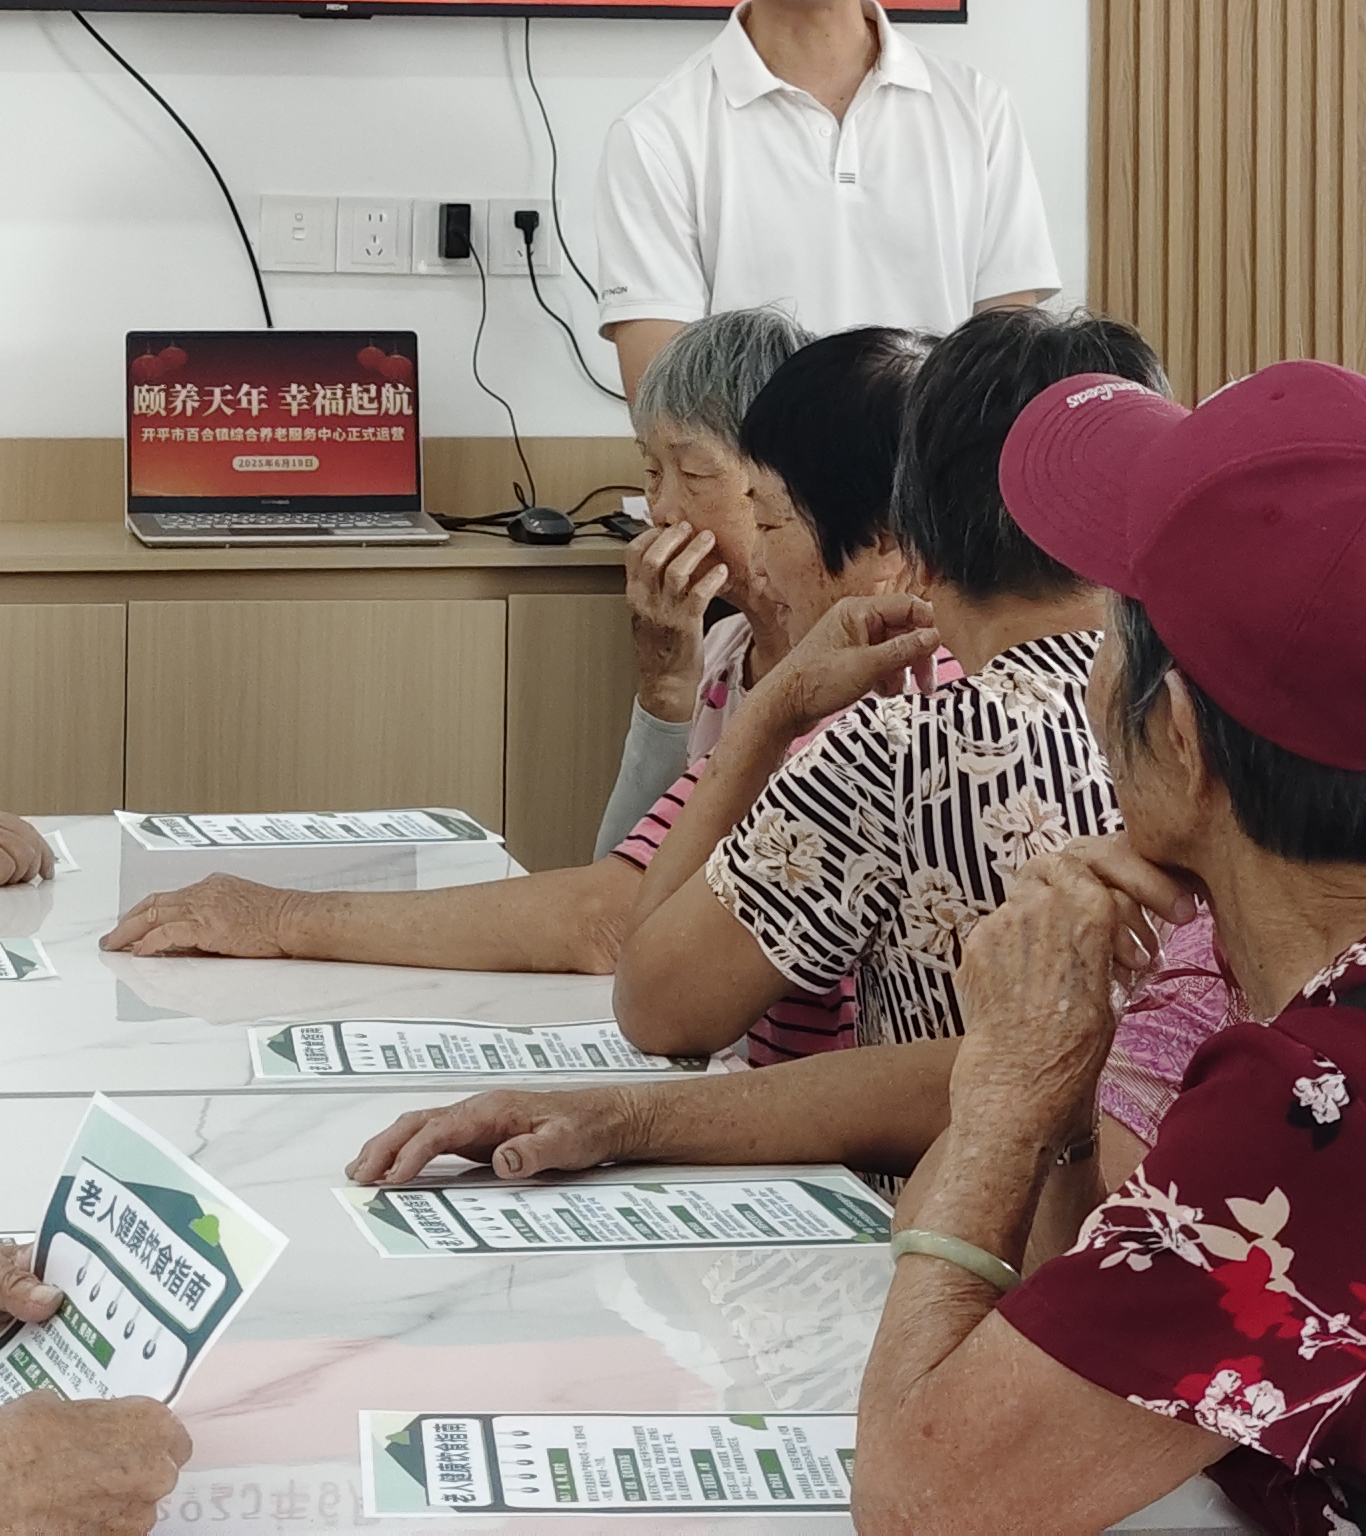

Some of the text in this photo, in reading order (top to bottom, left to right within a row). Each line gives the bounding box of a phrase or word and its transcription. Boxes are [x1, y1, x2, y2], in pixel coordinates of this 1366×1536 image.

[133, 383, 413, 417] 颐养天年 幸福起航
[141, 427, 405, 443] 开平市百合镇综合养老服务中心正式运营
[76, 1180, 212, 1312] 老人健康饮食指南
